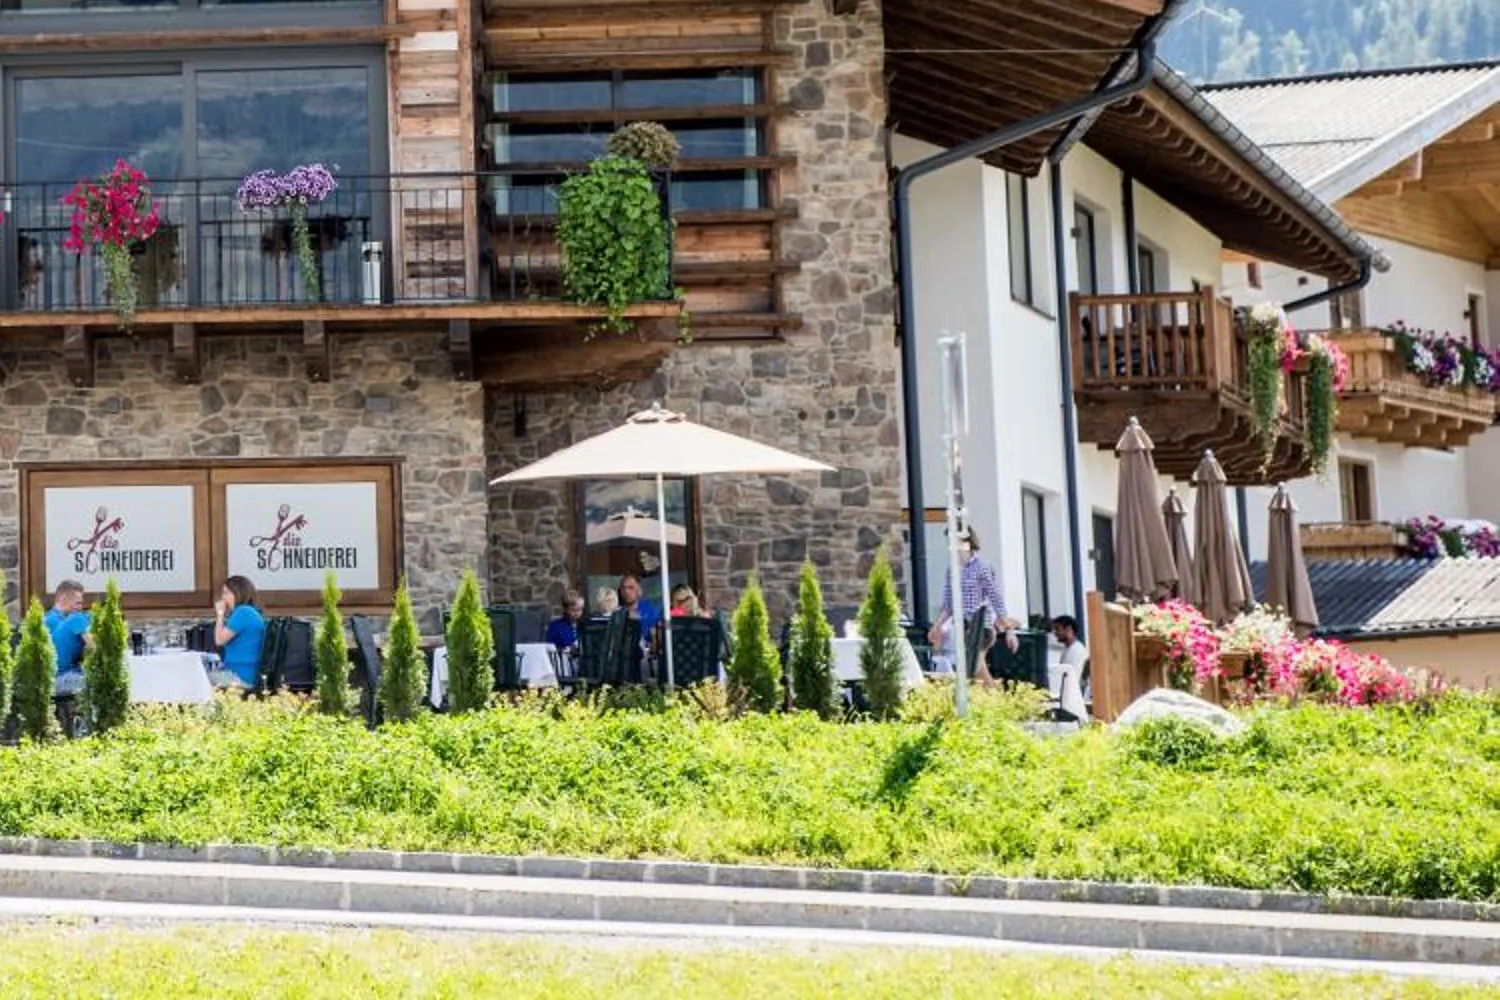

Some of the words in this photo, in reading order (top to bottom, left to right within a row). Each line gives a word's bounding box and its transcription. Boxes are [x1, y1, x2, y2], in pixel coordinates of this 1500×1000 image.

[100, 535, 119, 550] die
[283, 532, 302, 547] die
[74, 549, 174, 574] SCHNEIDEREI
[257, 547, 357, 572] SCHNEIDEREI
